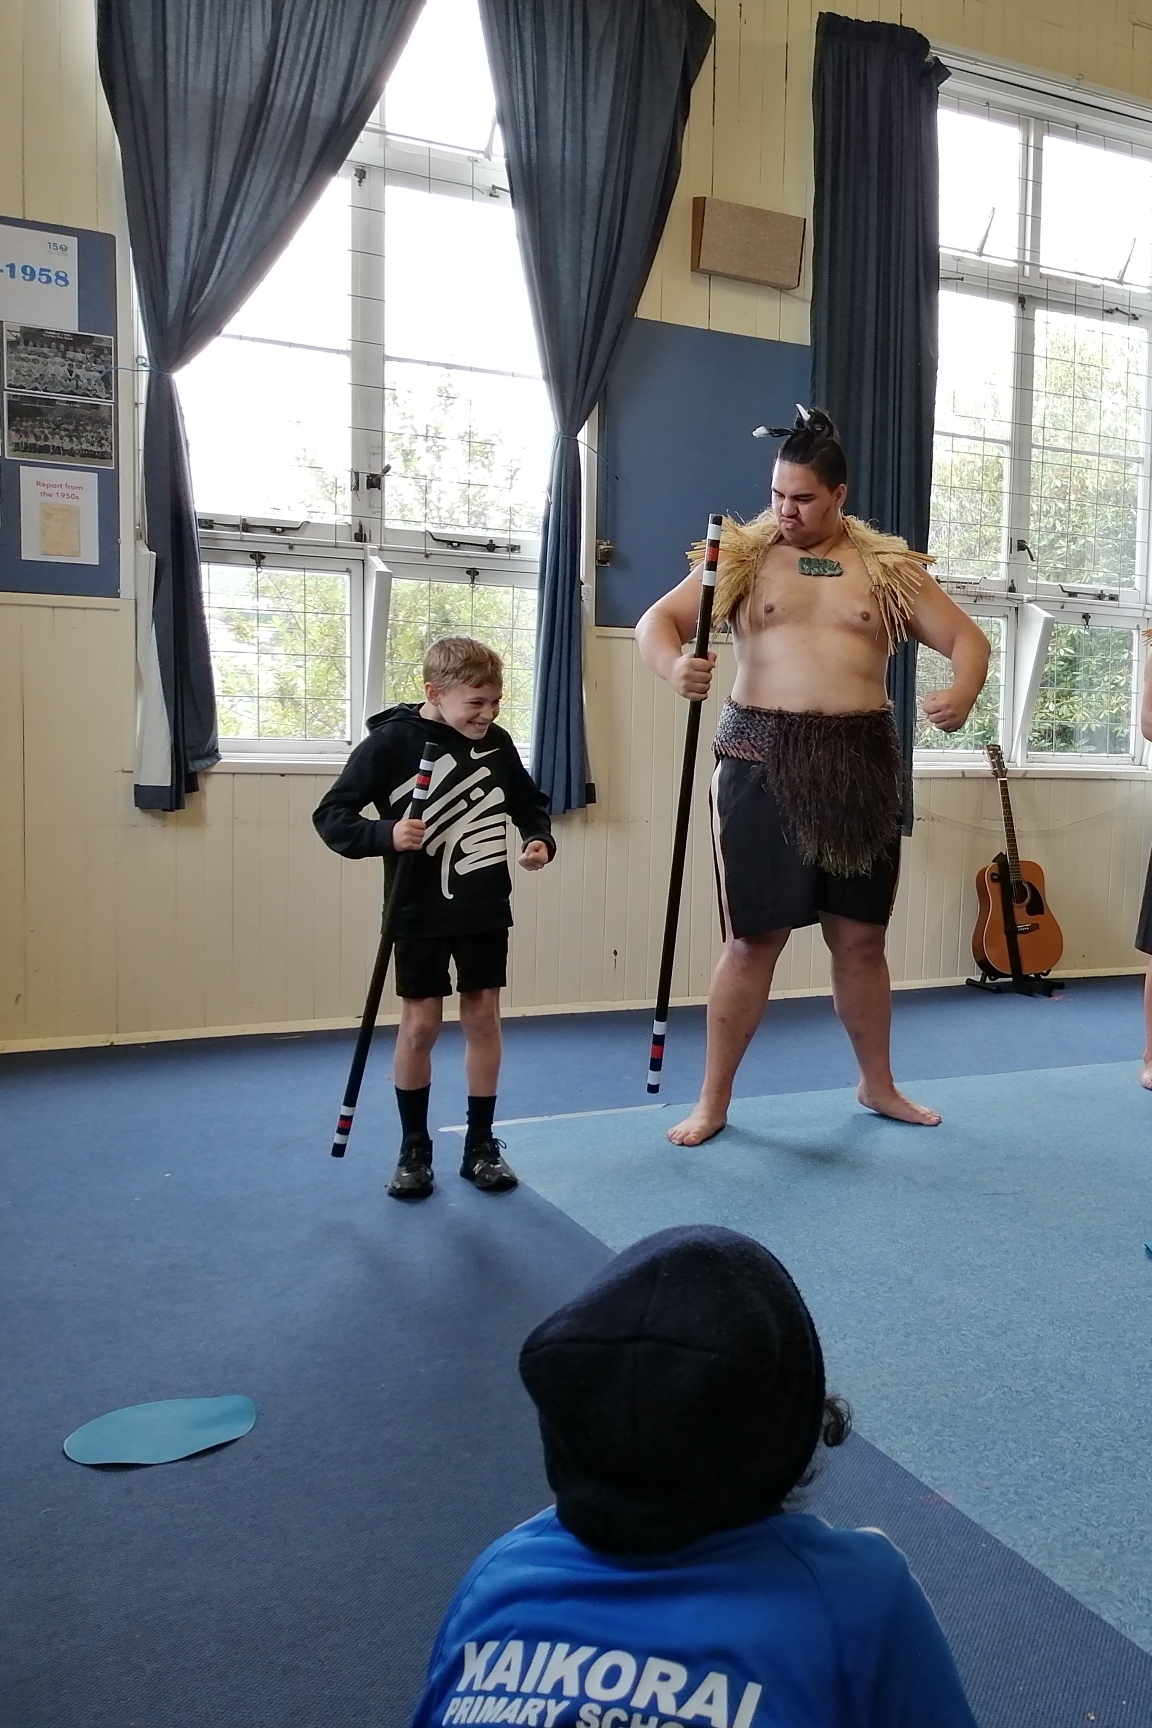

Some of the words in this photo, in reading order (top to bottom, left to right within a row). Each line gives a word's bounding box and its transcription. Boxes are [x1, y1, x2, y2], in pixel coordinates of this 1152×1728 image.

[35, 480, 63, 489] Report
[65, 482, 84, 491] from
[40, 490, 53, 498] the
[56, 491, 80, 500] 1950s
[442, 1695, 570, 1728] PRIMARY
